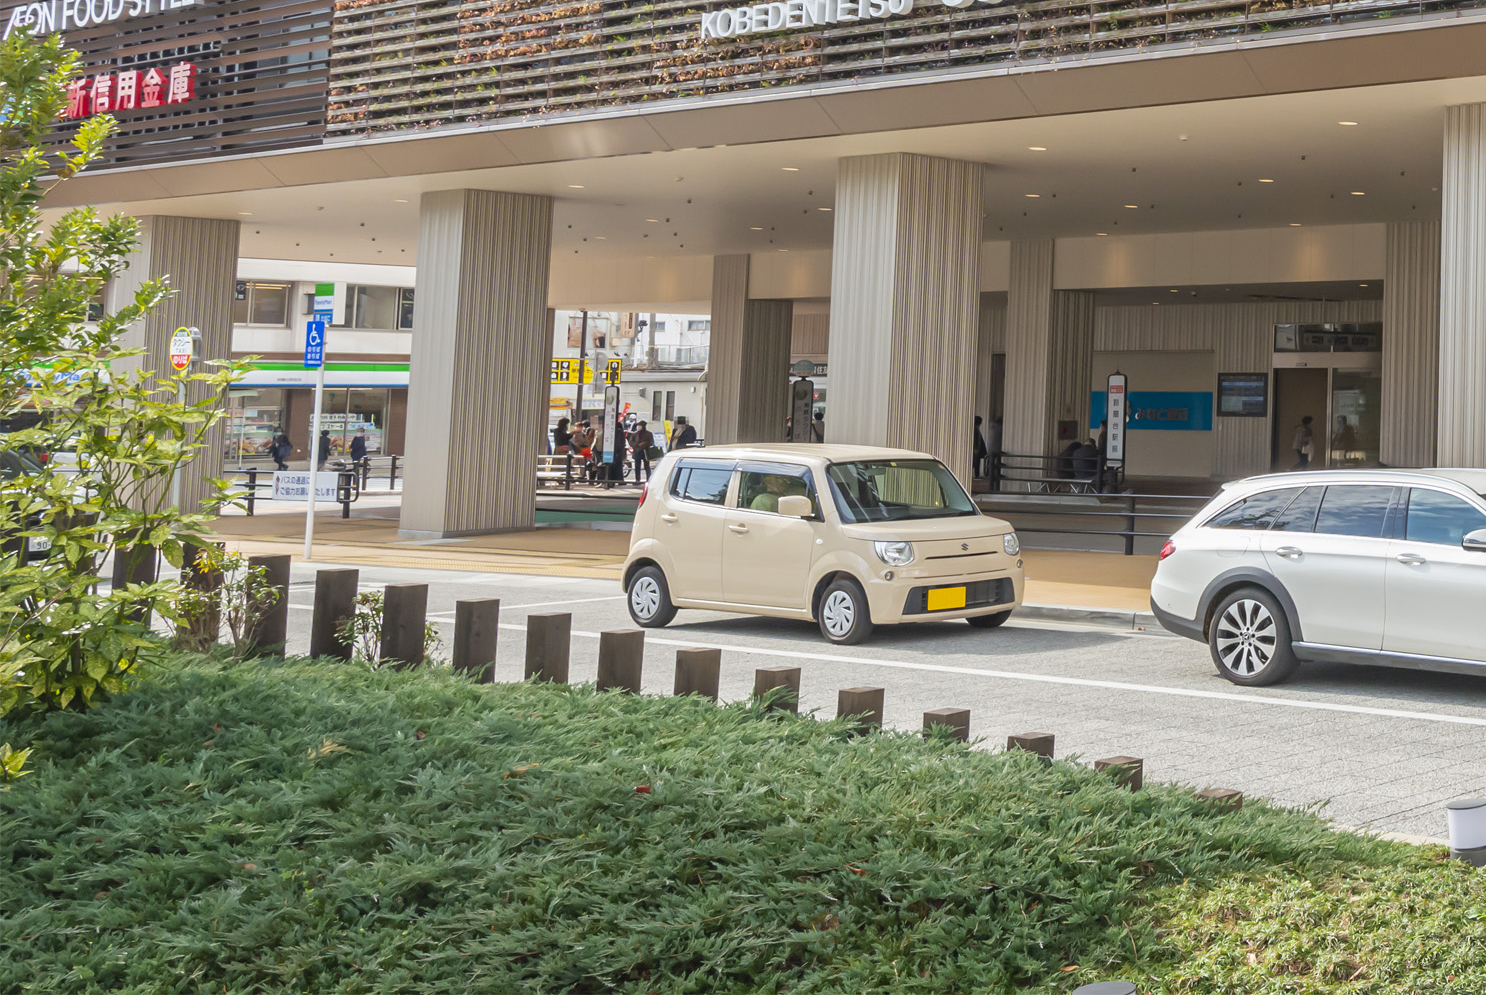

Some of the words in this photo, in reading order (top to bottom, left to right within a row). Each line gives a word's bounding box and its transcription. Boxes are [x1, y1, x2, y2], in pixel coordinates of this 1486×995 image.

[281, 487, 336, 497] ご協力お願いたします
